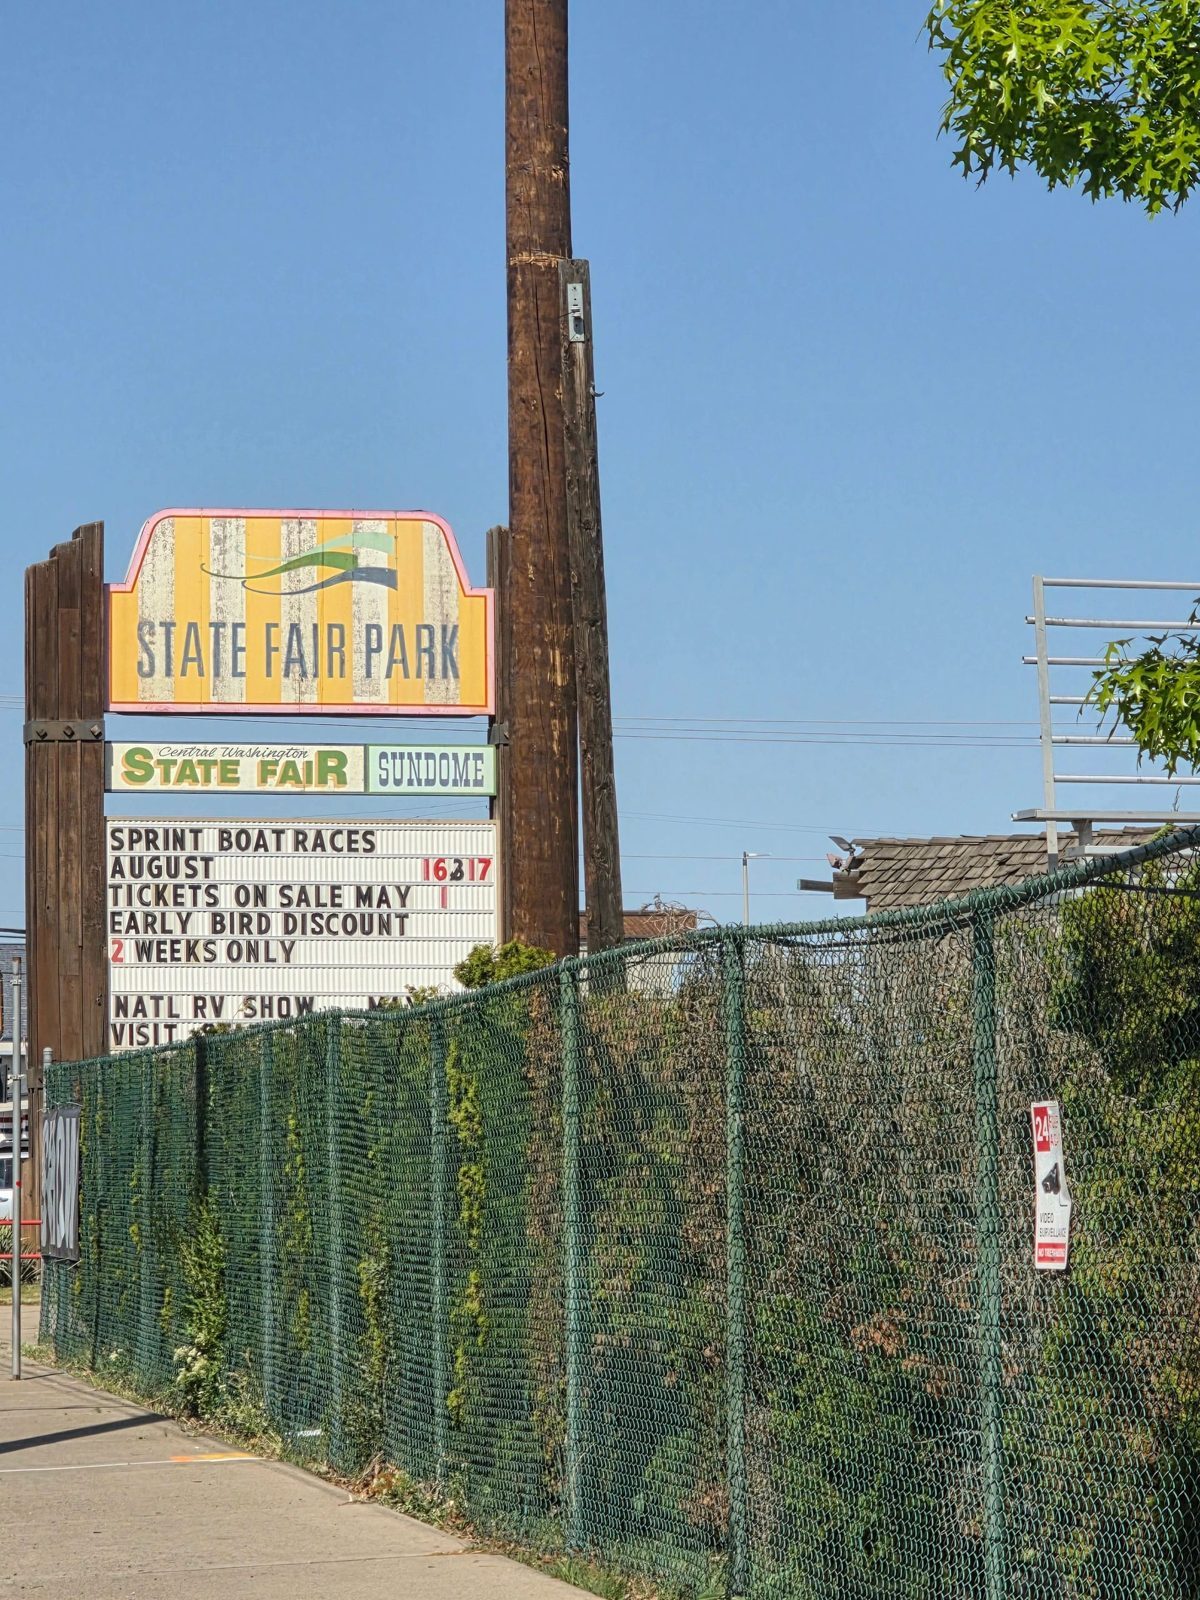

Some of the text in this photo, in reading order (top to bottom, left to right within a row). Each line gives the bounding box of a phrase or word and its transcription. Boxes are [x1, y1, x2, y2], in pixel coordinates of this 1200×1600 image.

[136, 621, 461, 680] STATE FAIR PARK
[158, 745, 309, 763] Central Washington
[124, 746, 349, 789] STATE FAIR
[378, 751, 484, 788] SUNDOME
[110, 827, 376, 854] SPRINT BOAT RACES
[110, 855, 214, 880] AUGUST
[109, 883, 448, 909] TICKETS ON SALE MAY 1
[110, 911, 409, 937] EARLY BIRD DISCOUNT
[110, 939, 297, 964] 2 WEEKS ONLY
[115, 995, 315, 1019] NATL RV SHOW
[111, 1023, 178, 1046] VISIT
[1036, 1115, 1049, 1142] 24
[1039, 1212, 1054, 1224] VIDEO
